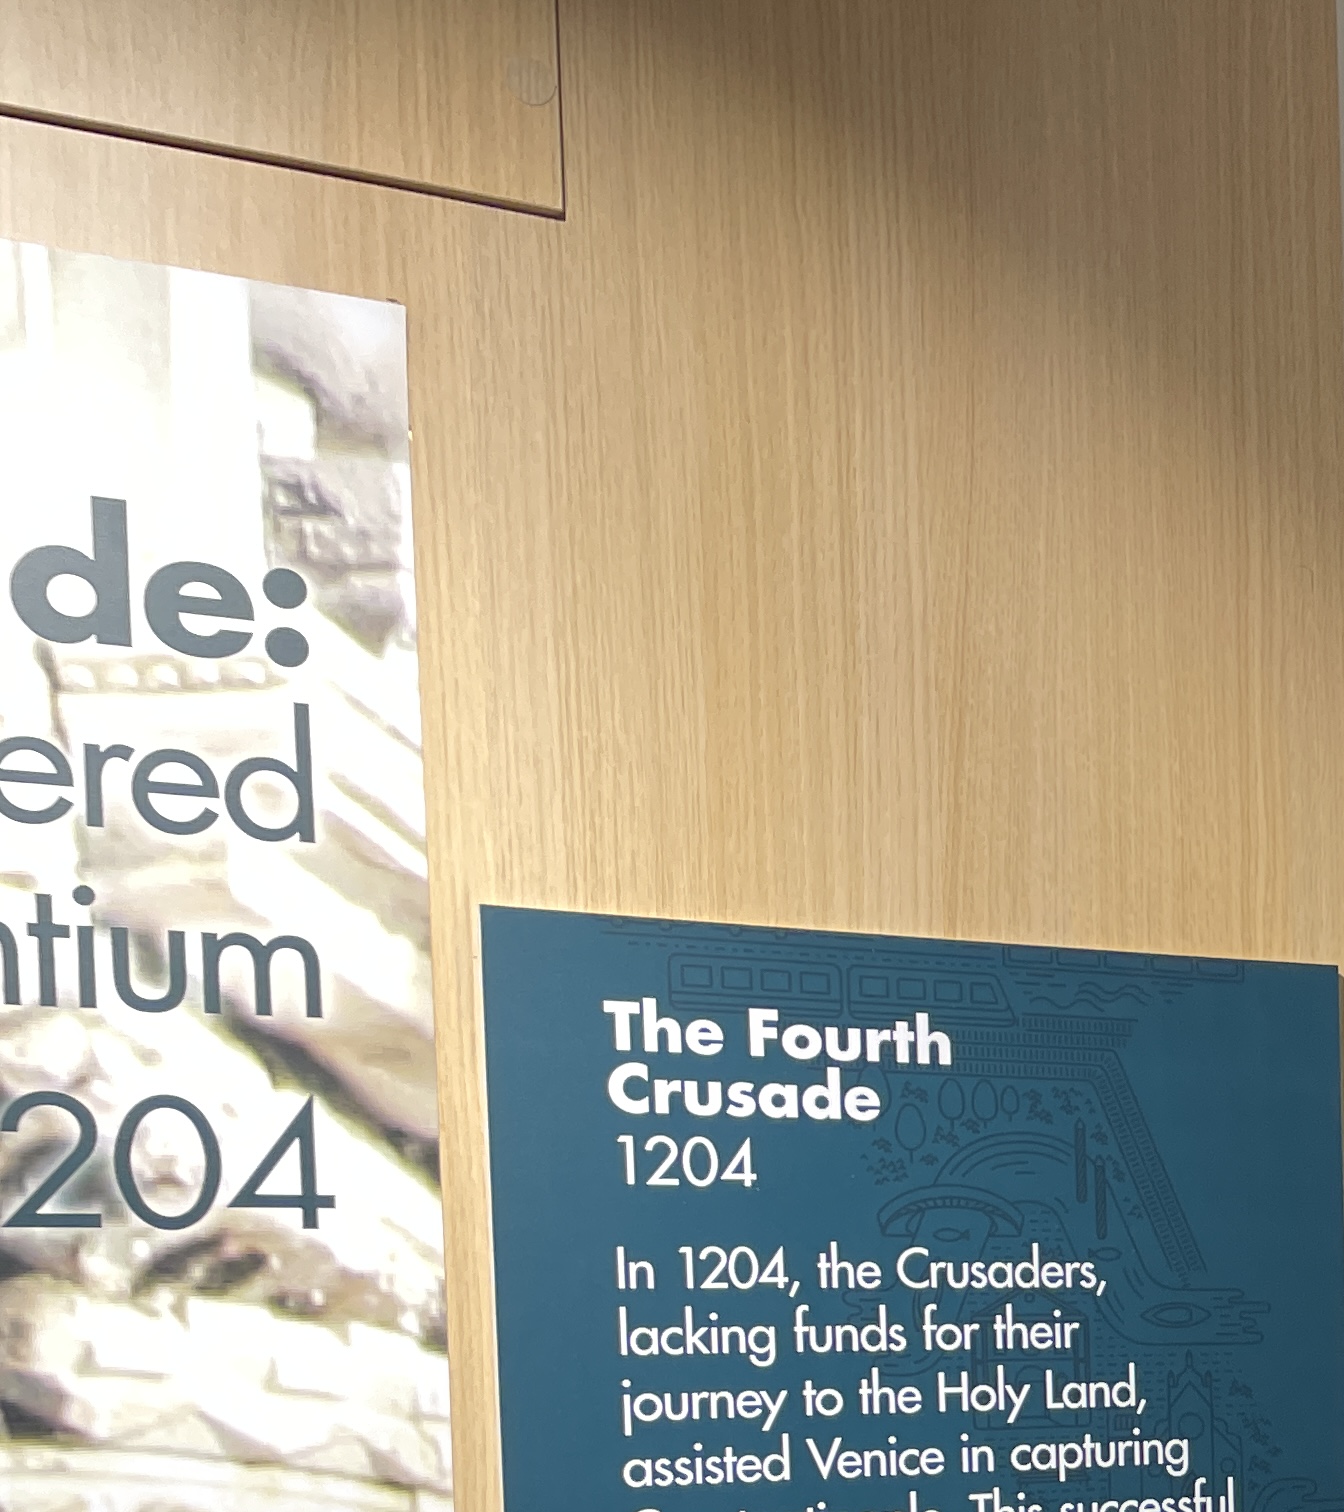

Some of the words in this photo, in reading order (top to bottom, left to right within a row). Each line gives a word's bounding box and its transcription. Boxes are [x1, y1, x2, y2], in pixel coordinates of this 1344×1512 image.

[602, 997, 724, 1056] The
[748, 1008, 951, 1065] Fourth
[607, 1062, 880, 1121] Crusade
[617, 1135, 757, 1187] 1204
[616, 1246, 655, 1289] In
[678, 1246, 800, 1298] 1204,
[817, 1241, 882, 1289] the
[897, 1243, 1106, 1296] Crusaders,
[619, 1305, 776, 1367] lacking
[793, 1304, 907, 1353] funds
[922, 1303, 980, 1351] for
[993, 1303, 1080, 1349] their
[621, 1379, 788, 1436] journey
[802, 1380, 843, 1416] to
[859, 1367, 922, 1414] the
[938, 1365, 1031, 1423] Holy
[1046, 1362, 1146, 1415] Land,
[623, 1433, 790, 1488] assisted
[805, 1436, 945, 1480] Venice
[960, 1433, 994, 1473] in
[1011, 1427, 1189, 1482] capturing
